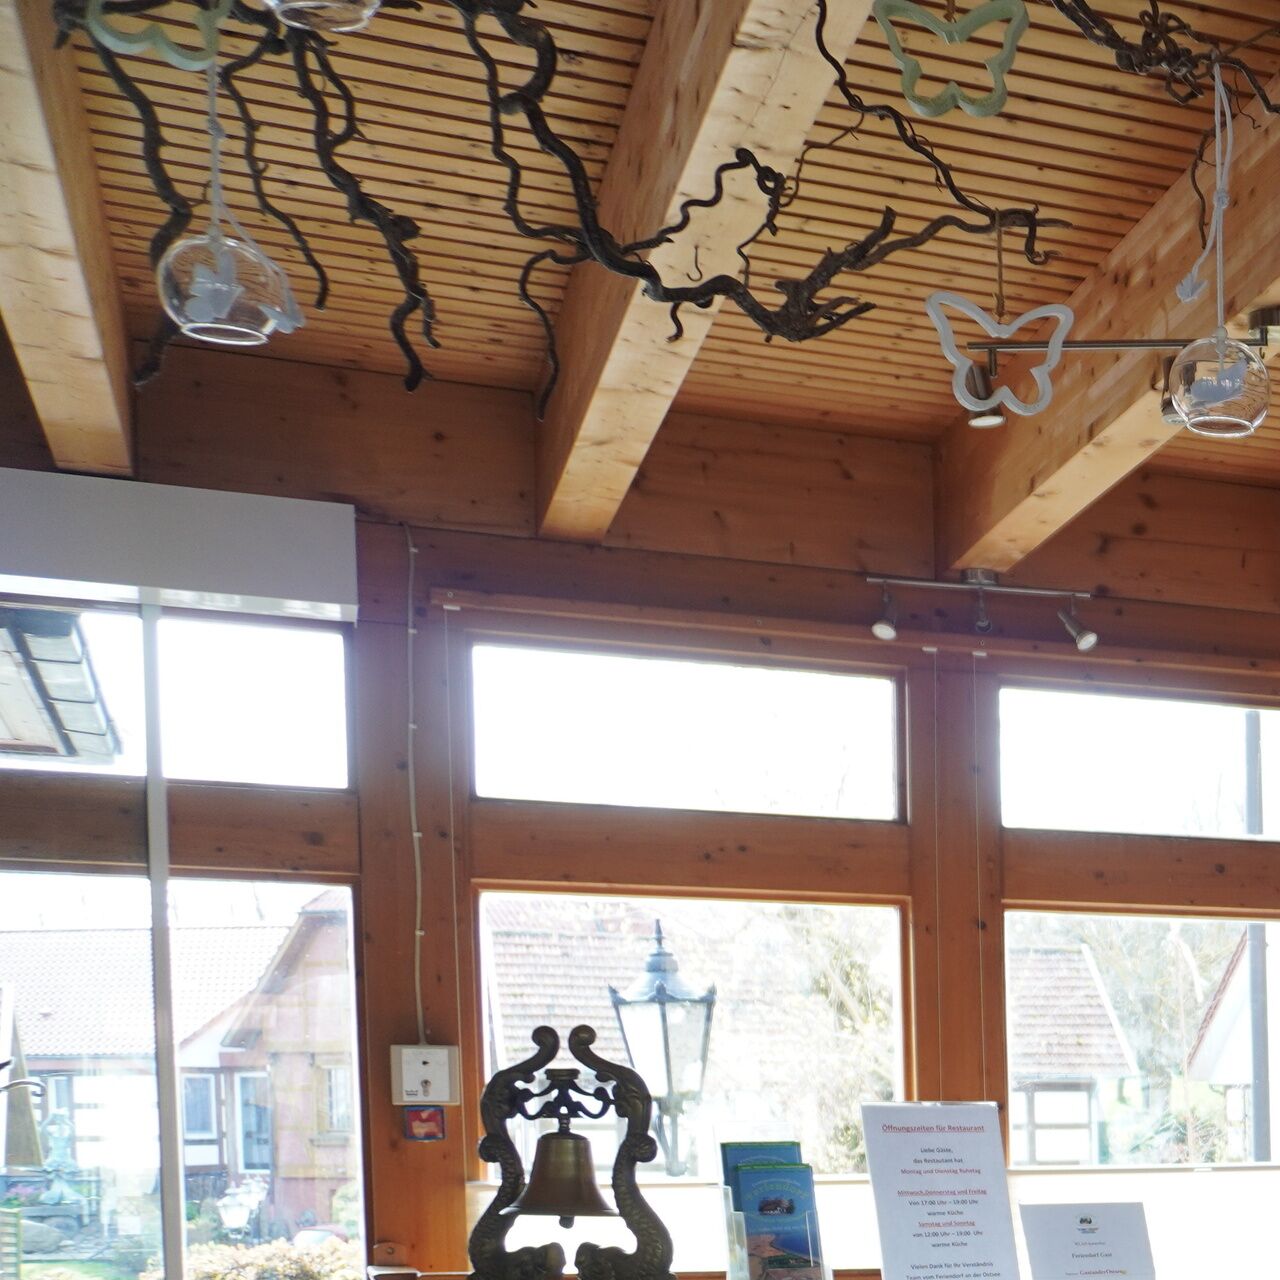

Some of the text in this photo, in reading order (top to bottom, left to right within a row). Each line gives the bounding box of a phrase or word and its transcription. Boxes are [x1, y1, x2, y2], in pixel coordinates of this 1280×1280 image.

[882, 1124, 985, 1133] Öffnungszeiten für Restaurant
